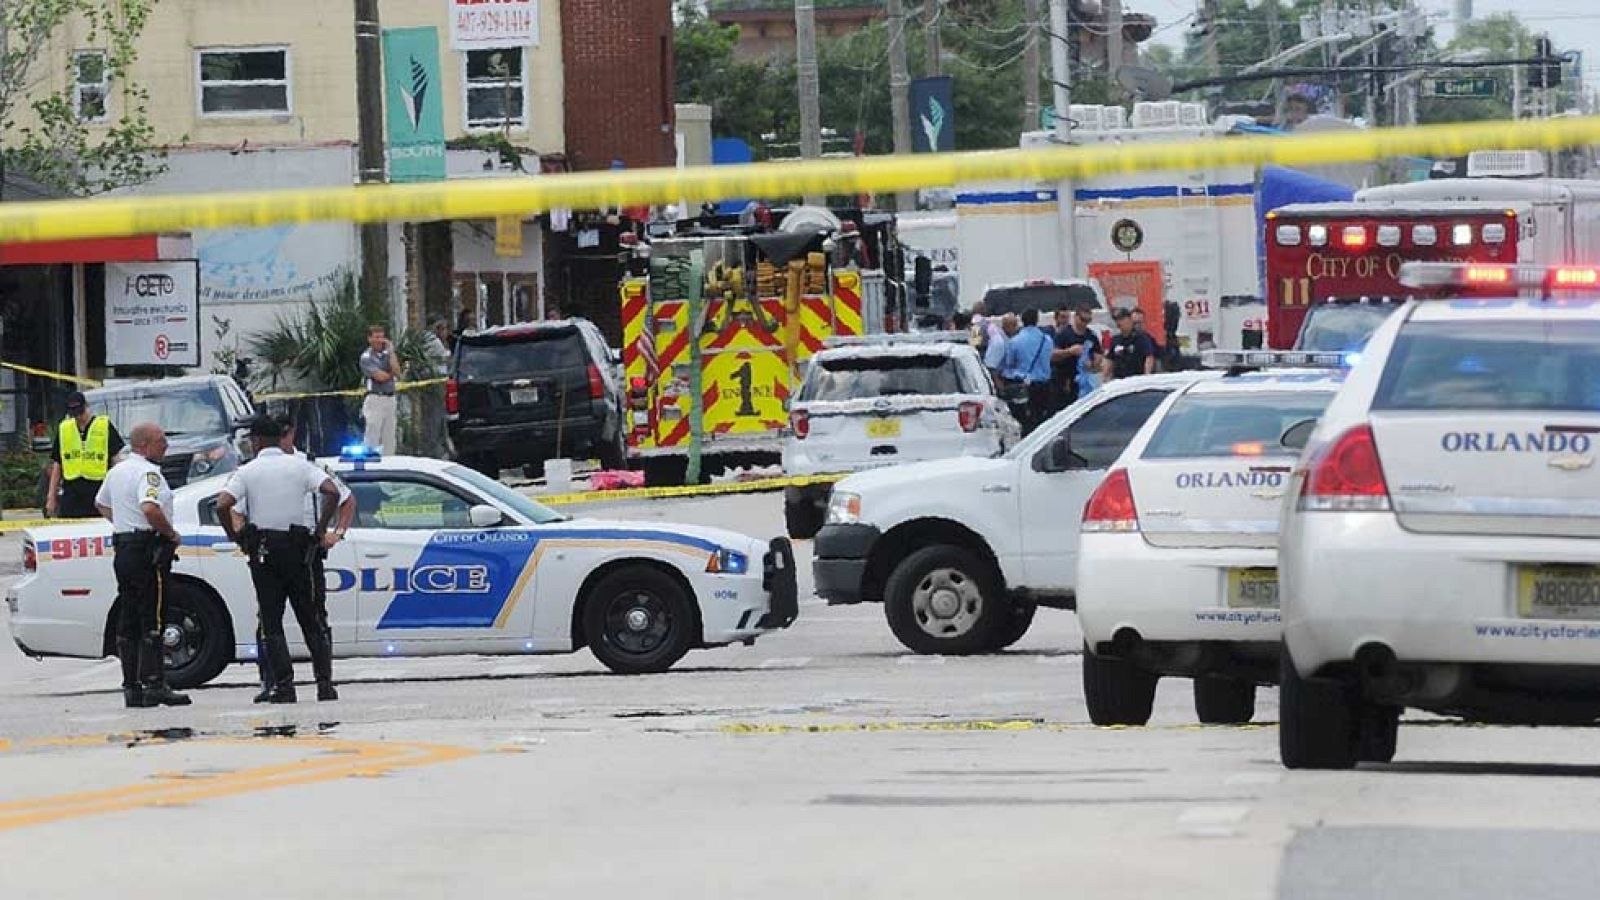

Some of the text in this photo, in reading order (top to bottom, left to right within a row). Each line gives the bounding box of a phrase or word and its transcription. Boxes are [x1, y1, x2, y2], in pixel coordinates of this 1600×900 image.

[391, 145, 442, 159] SOUTH
[1184, 300, 1210, 316] 911
[730, 362, 761, 416] 1
[1440, 431, 1590, 453] ORLANDO
[1175, 472, 1283, 488] ORLANDO
[52, 536, 104, 560] 911
[324, 565, 491, 593] OLICE
